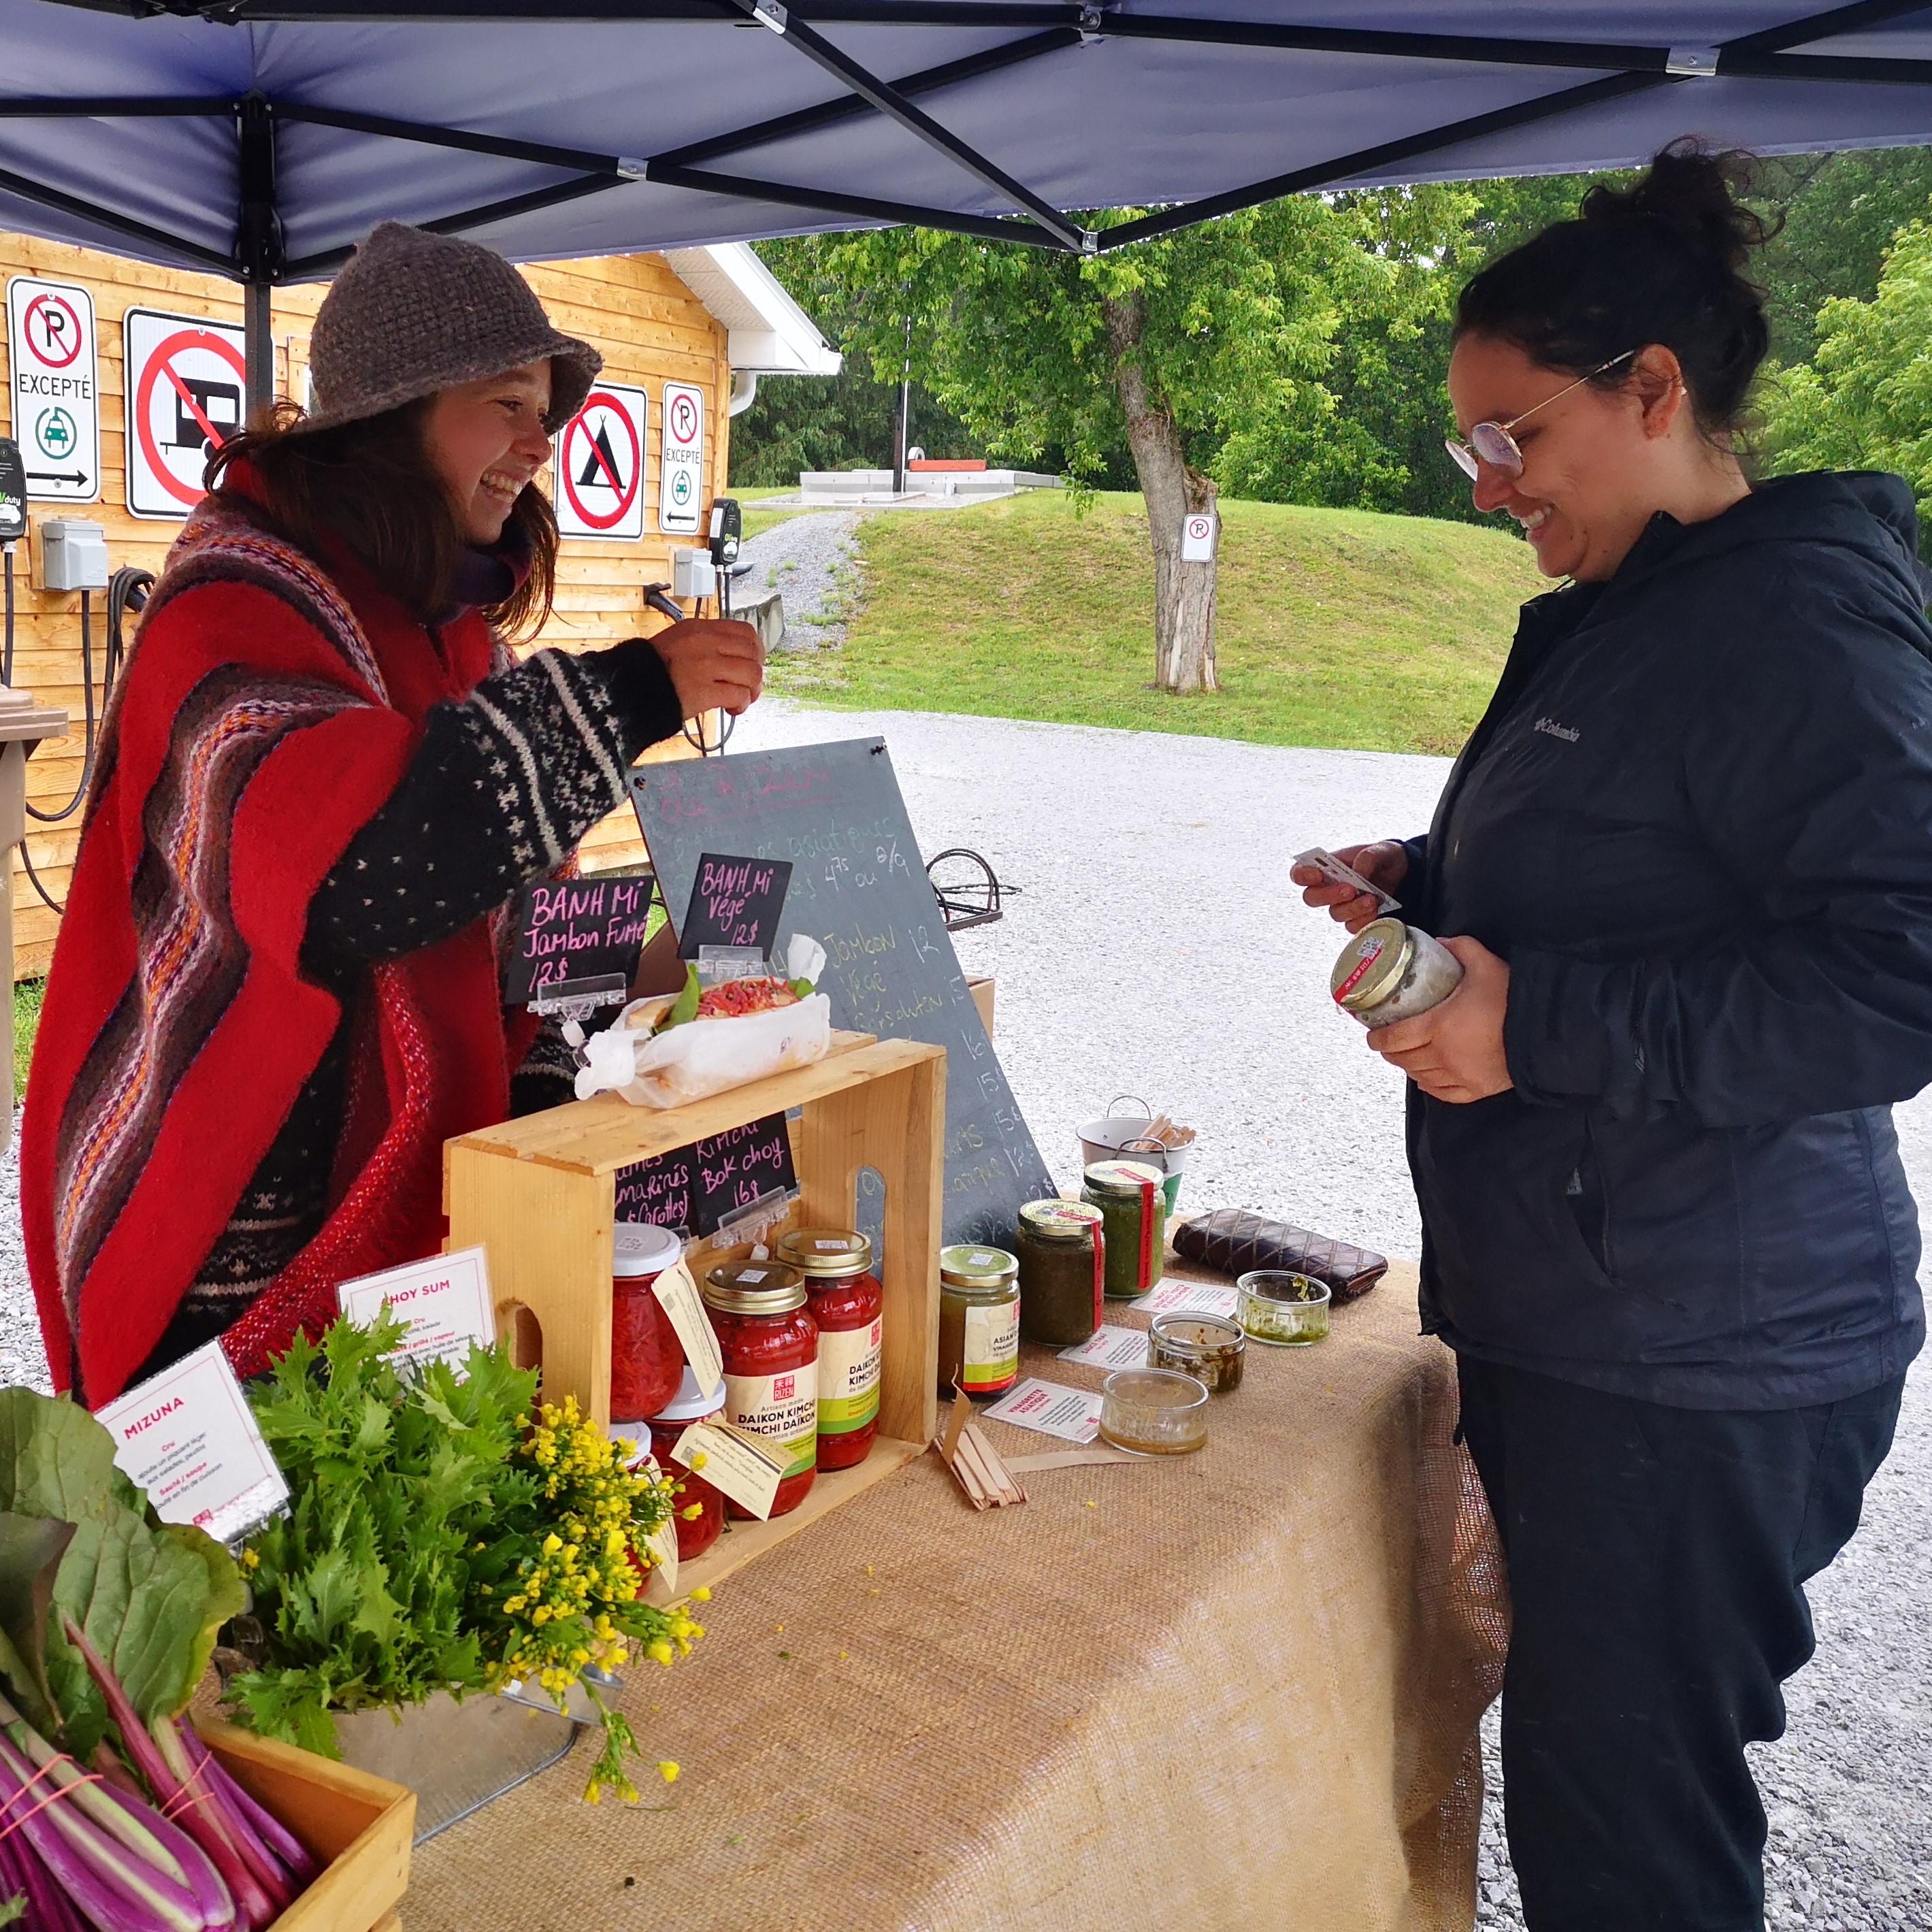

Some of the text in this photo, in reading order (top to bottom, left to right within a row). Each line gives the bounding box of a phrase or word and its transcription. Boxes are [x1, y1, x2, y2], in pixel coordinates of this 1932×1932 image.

[19, 374, 91, 400] EXCEPTÉ
[666, 447, 700, 465] EXCEPTÉ
[1539, 718, 1580, 743] Columbia
[700, 862, 753, 897] BANH
[531, 883, 605, 928] BANH
[523, 923, 600, 958] Jambon
[730, 919, 759, 947] 12$
[528, 956, 569, 994] 12$
[742, 1137, 786, 1170] choy
[422, 1279, 450, 1295] SUM
[774, 1388, 794, 1400] RIZEN
[1007, 1388, 1044, 1413] VINAIGRETTE
[1019, 1393, 1049, 1414] ASIATIQUE
[124, 1397, 185, 1439] MIZUNA
[738, 1399, 816, 1424] DAIKON KIMCHI
[783, 1411, 815, 1430] DAÏKON
[161, 1441, 176, 1452] Cru
